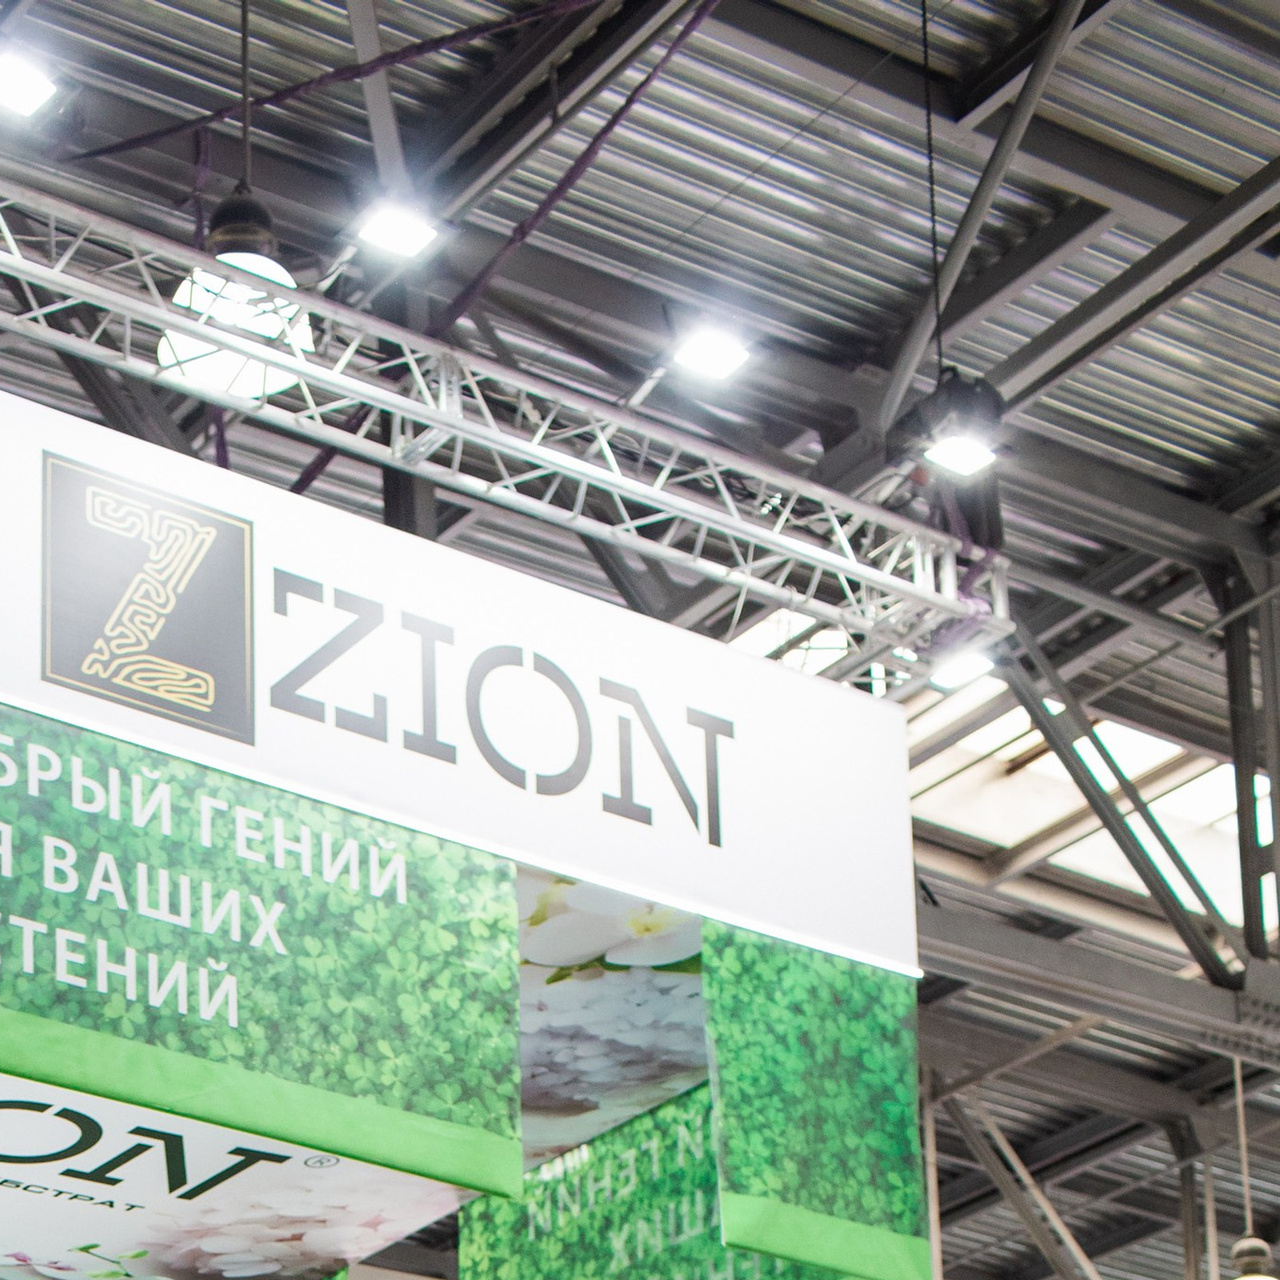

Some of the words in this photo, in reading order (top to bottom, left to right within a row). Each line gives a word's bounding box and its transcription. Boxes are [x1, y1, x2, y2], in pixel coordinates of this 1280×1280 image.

[270, 568, 734, 847] ZION
[44, 836, 286, 956] ВАШИХ
[200, 790, 409, 908] ГЕНИЙ
